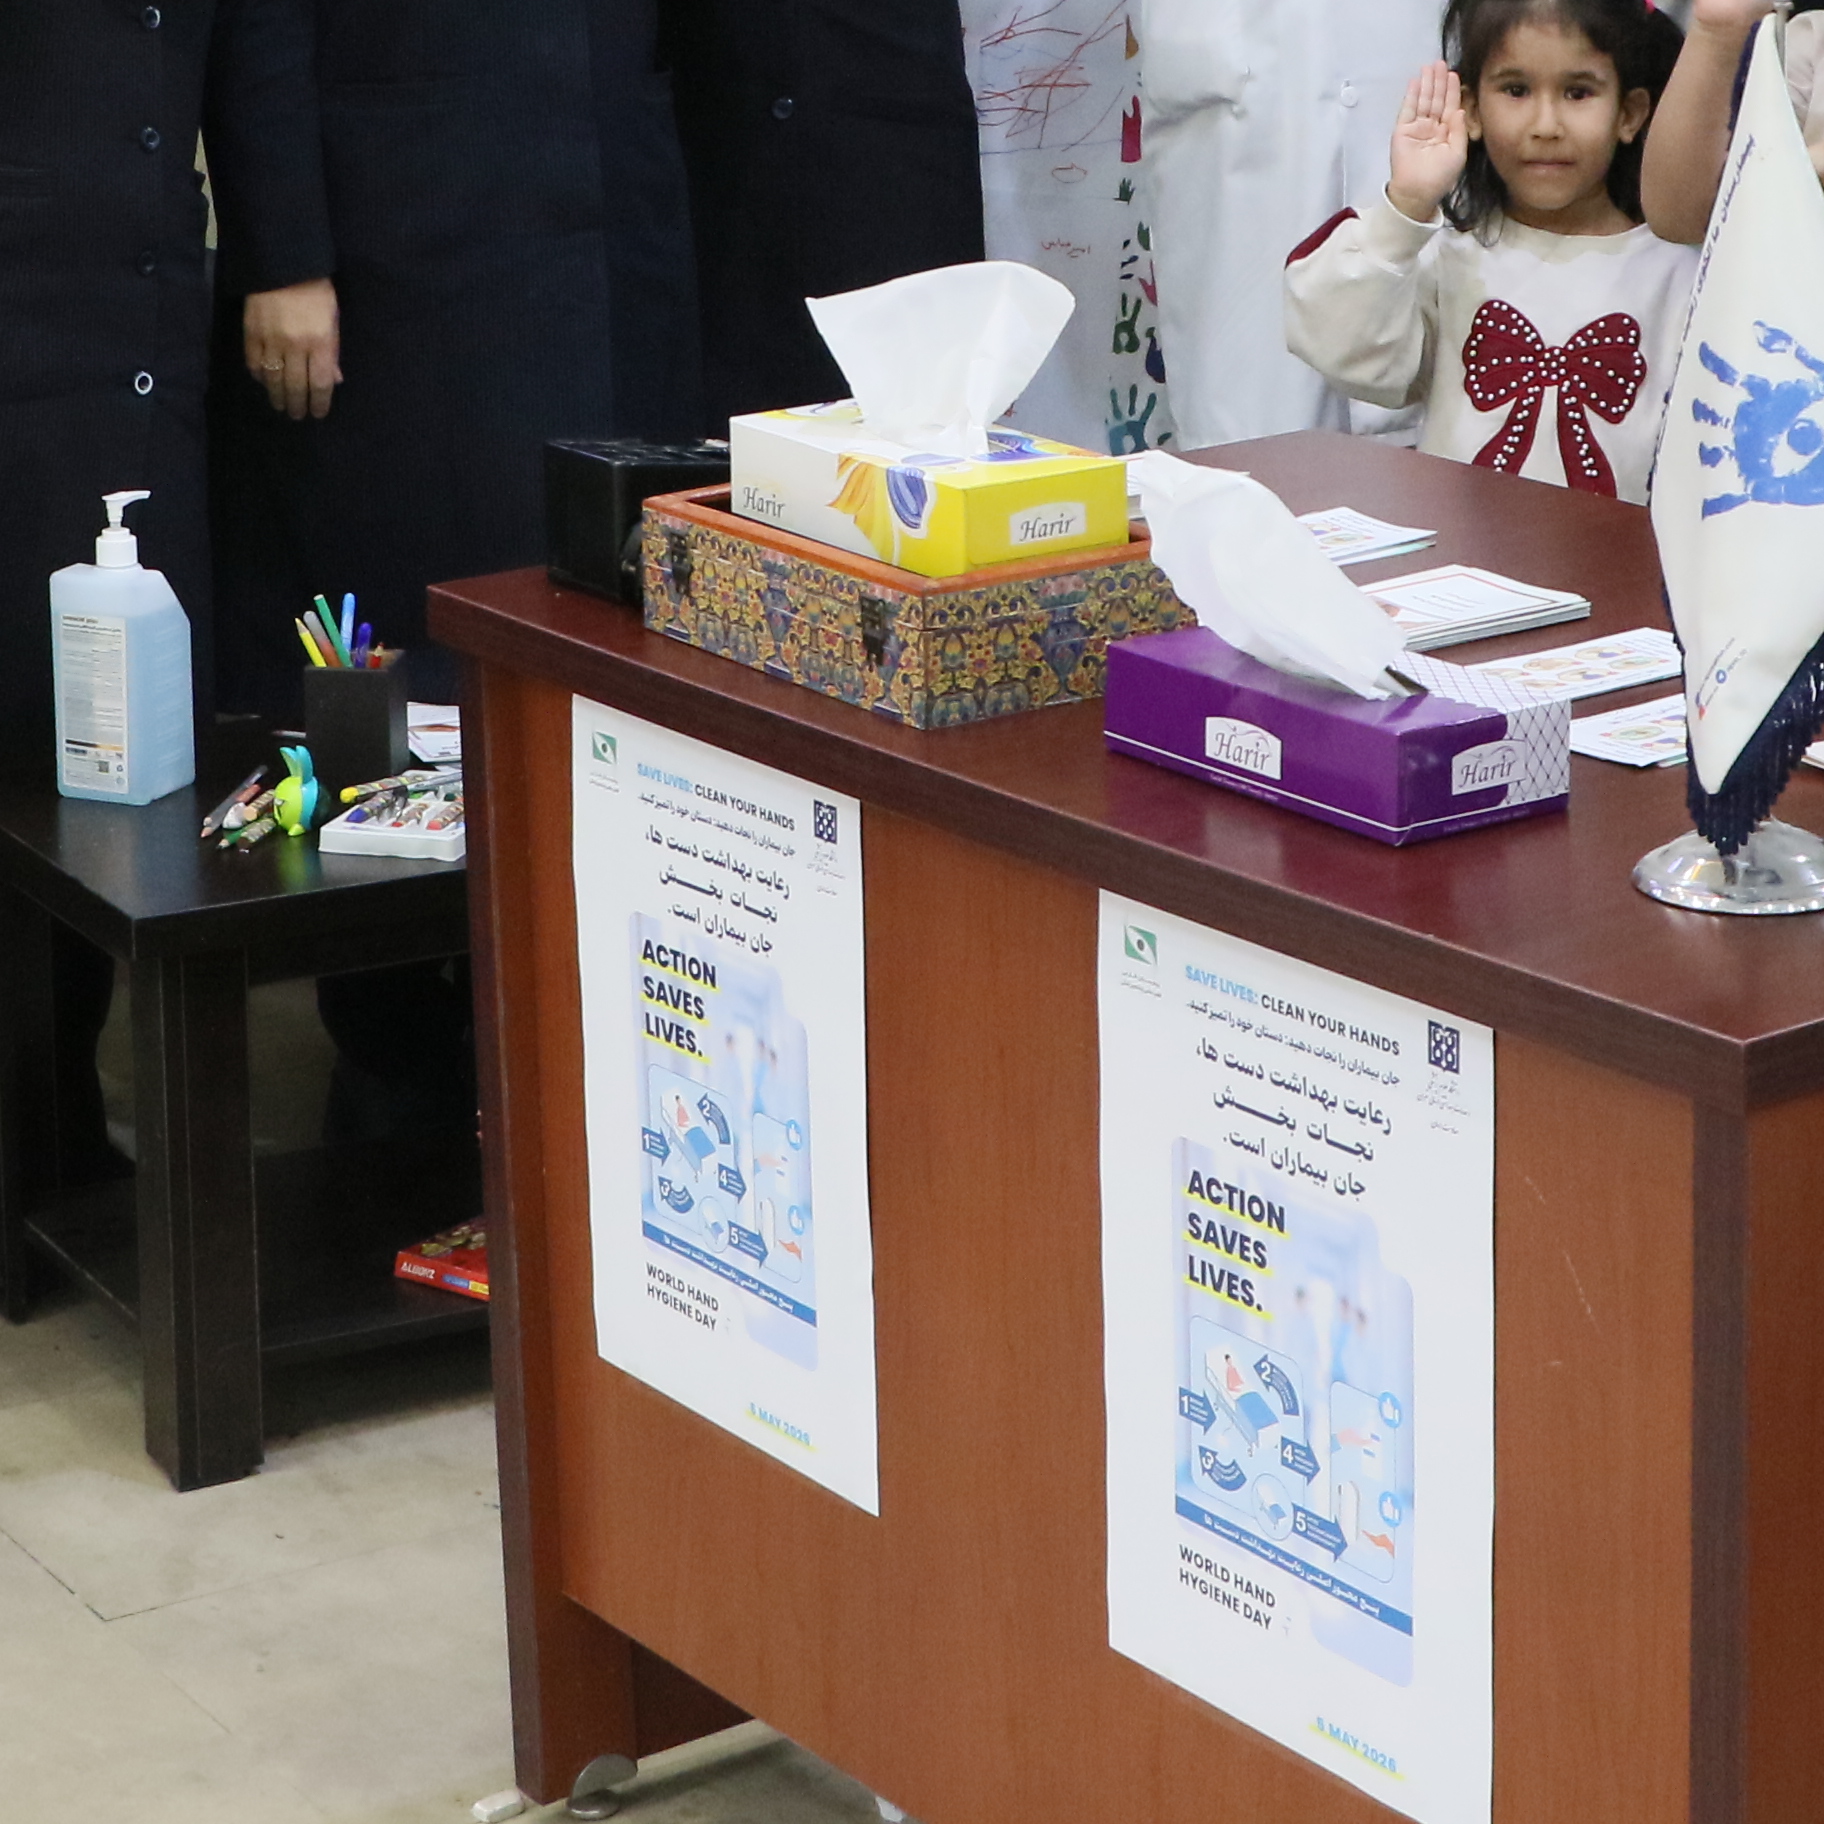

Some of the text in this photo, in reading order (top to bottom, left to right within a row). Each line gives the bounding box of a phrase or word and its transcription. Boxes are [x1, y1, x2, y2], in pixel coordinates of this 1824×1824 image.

[743, 486, 786, 519] Harir
[1019, 512, 1076, 542] Harir
[1214, 728, 1271, 772] Harir
[1460, 752, 1519, 789] Harir
[695, 784, 727, 806] CLEAN
[729, 795, 757, 818] YOUR
[759, 807, 796, 832] HANDS
[666, 835, 699, 858] دست
[702, 849, 752, 880] بهداشت
[756, 870, 790, 900] رعایت
[704, 914, 746, 948] بیماران
[750, 933, 773, 958] جان
[642, 938, 717, 989] ACTION
[643, 975, 705, 1020] SAVES
[1185, 964, 1219, 992] SAVE
[1219, 976, 1259, 1005] LIVES:
[1261, 993, 1305, 1022] CLEAN
[1307, 1009, 1347, 1037] YOUR
[1349, 1024, 1401, 1057] HANDS
[645, 1012, 703, 1057] LIVES.
[1223, 1049, 1264, 1080] دست
[1347, 1054, 1380, 1081] بیماران
[1381, 1065, 1401, 1088] جان
[1269, 1068, 1338, 1113] بهداشت
[700, 1099, 711, 1116] 2
[1344, 1100, 1393, 1136] رعایت
[642, 1133, 651, 1149] 1
[720, 1170, 728, 1186] 4
[1270, 1146, 1329, 1189] بیماران
[660, 1181, 670, 1197] 3
[1187, 1169, 1286, 1234] ACTION
[1334, 1172, 1366, 1202] جان
[730, 1227, 739, 1244] 5
[1188, 1212, 1268, 1270] SAVES
[646, 1262, 719, 1312] WORLD HAND
[1188, 1254, 1264, 1313] LIVES.
[647, 1283, 717, 1332] HYGIENE DAY
[1260, 1361, 1272, 1383] 2
[758, 1407, 781, 1429] MAY
[1180, 1394, 1191, 1414] 1
[1202, 1451, 1214, 1470] 3
[1282, 1444, 1294, 1465] 4
[1295, 1510, 1308, 1533] 5
[1179, 1543, 1276, 1609] WORLD HAND
[1179, 1567, 1272, 1631] HYGIENE DAY
[1328, 1722, 1359, 1751] MAY
